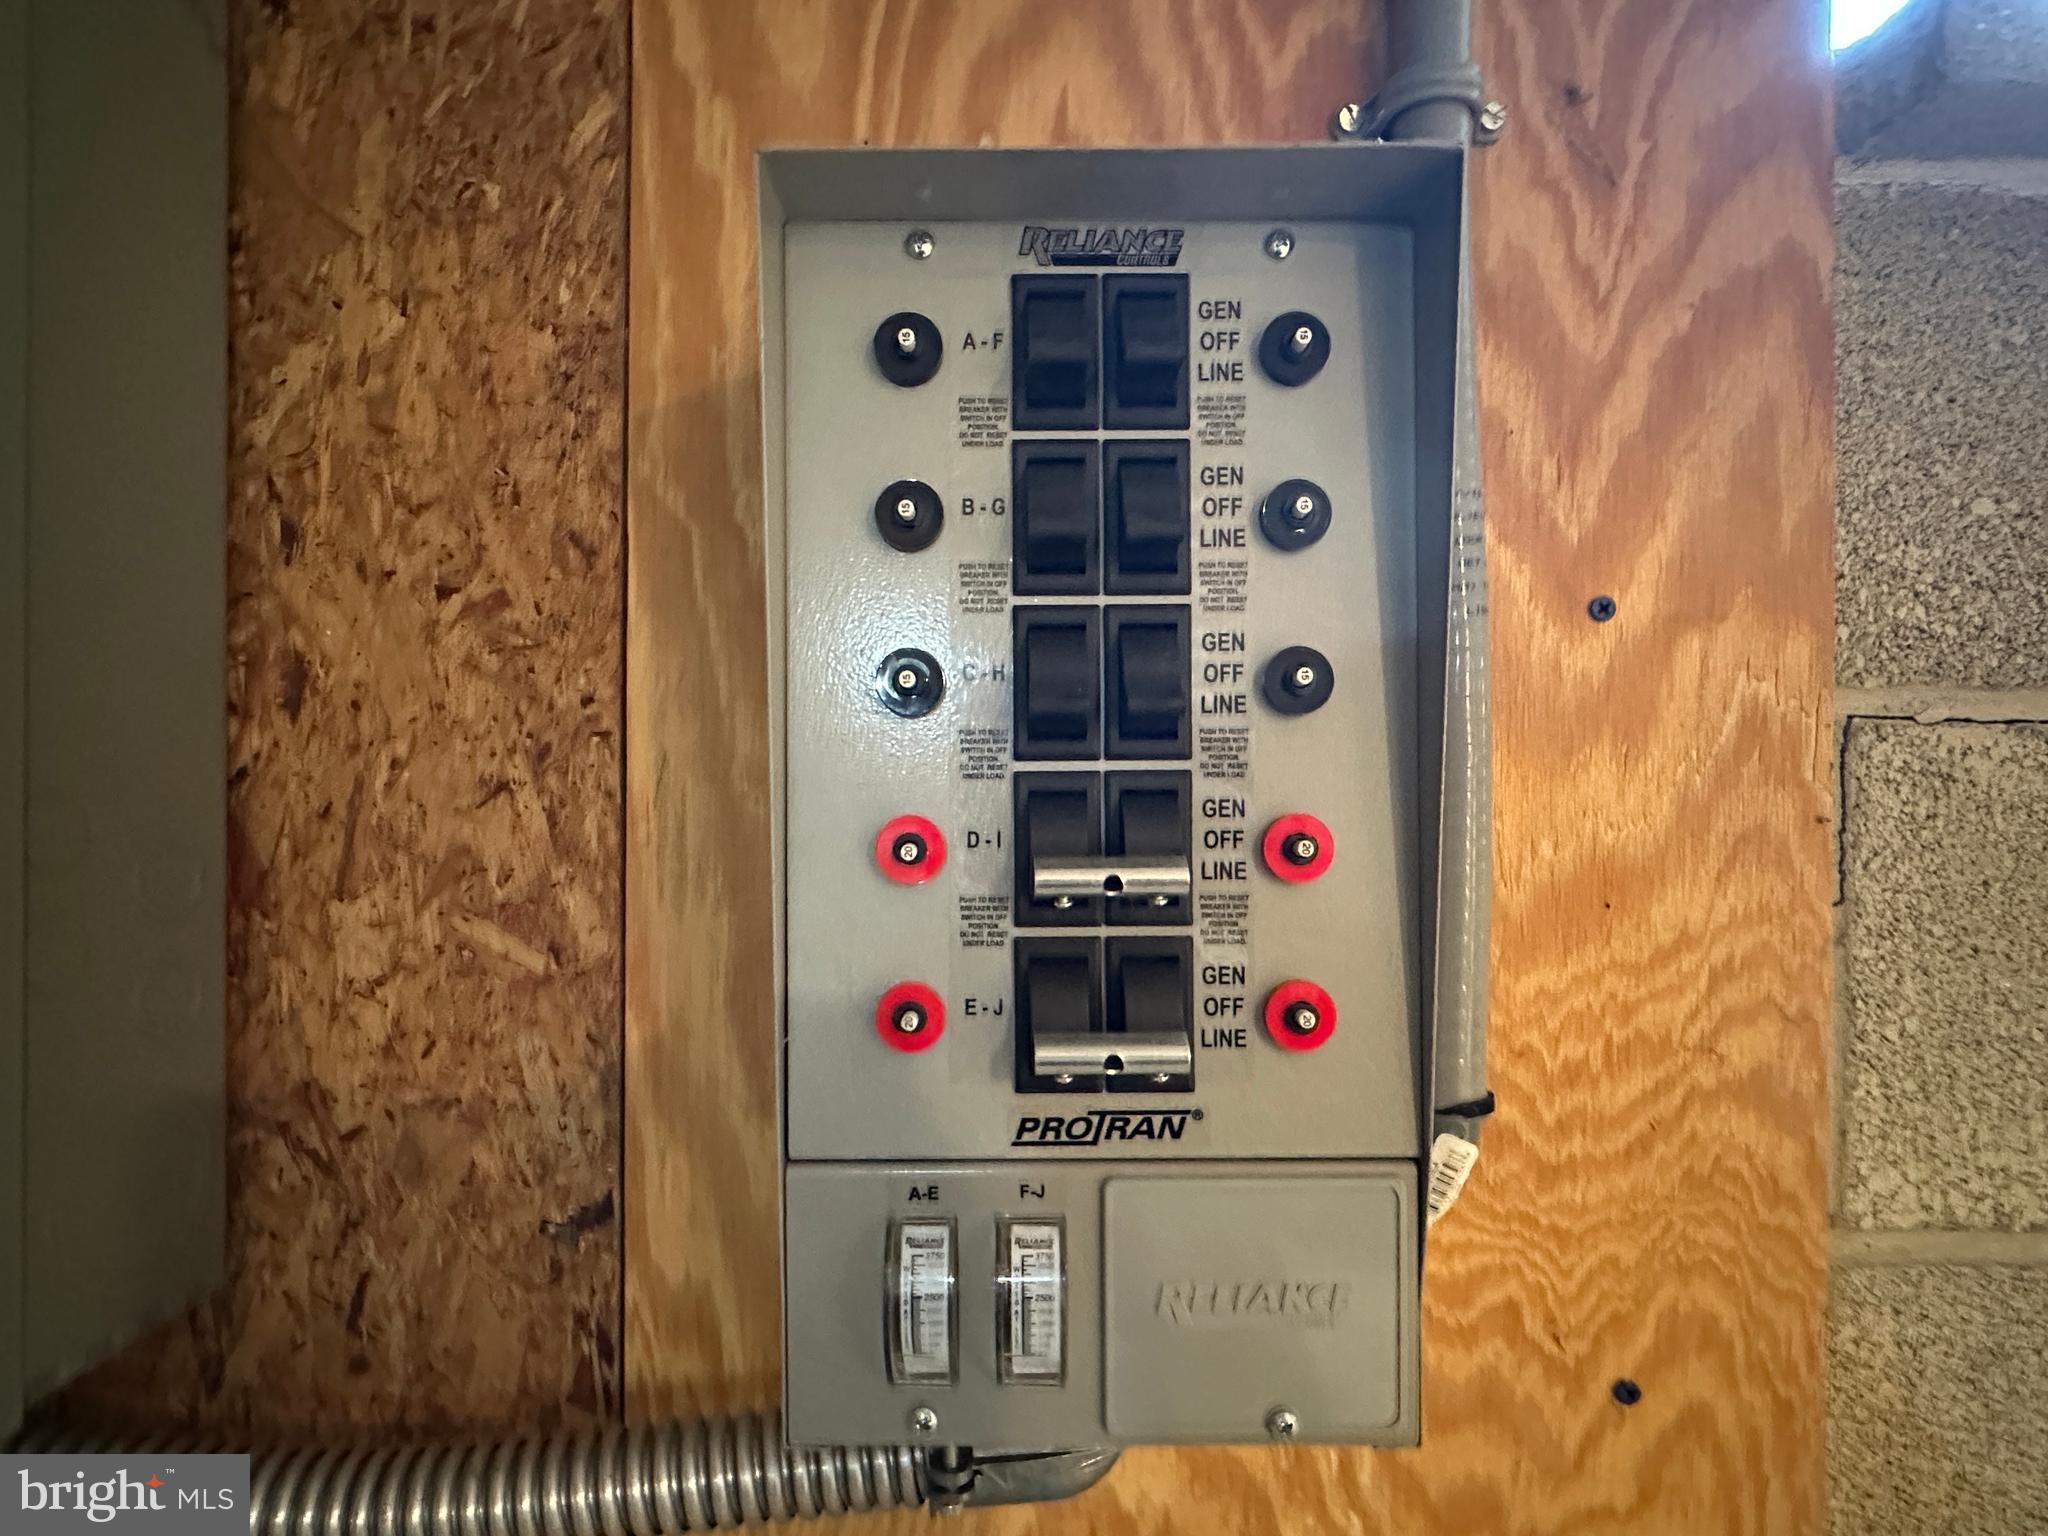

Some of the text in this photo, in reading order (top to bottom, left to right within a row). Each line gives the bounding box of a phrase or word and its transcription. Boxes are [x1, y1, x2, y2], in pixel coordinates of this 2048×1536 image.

[1018, 226, 1184, 266] RELIANCE
[1198, 301, 1241, 320] GEN
[901, 331, 911, 342] 15
[1200, 332, 1240, 351] OFF
[1299, 330, 1309, 340] 15
[1198, 363, 1243, 382] LINE
[1200, 466, 1244, 486] GEN
[901, 503, 911, 514] 15
[1202, 497, 1242, 517] OFF
[1300, 499, 1309, 510] 15
[1200, 529, 1246, 548] LINE
[1202, 633, 1245, 652] GEN
[902, 674, 911, 684] 15
[1204, 664, 1243, 683] OFF
[1301, 669, 1310, 680] 15
[1201, 695, 1247, 714] LINE
[1202, 799, 1246, 818] GEN
[1204, 830, 1244, 849] OFF
[1302, 842, 1311, 853] 20
[904, 845, 913, 857] 20
[1201, 861, 1247, 881] LINE
[1202, 966, 1246, 985] GEN
[1204, 997, 1244, 1016] OFF
[1303, 1015, 1312, 1026] 20
[1201, 1029, 1247, 1048] LINE
[908, 1186, 940, 1201] A-E
[1020, 1184, 1046, 1199] F-J
